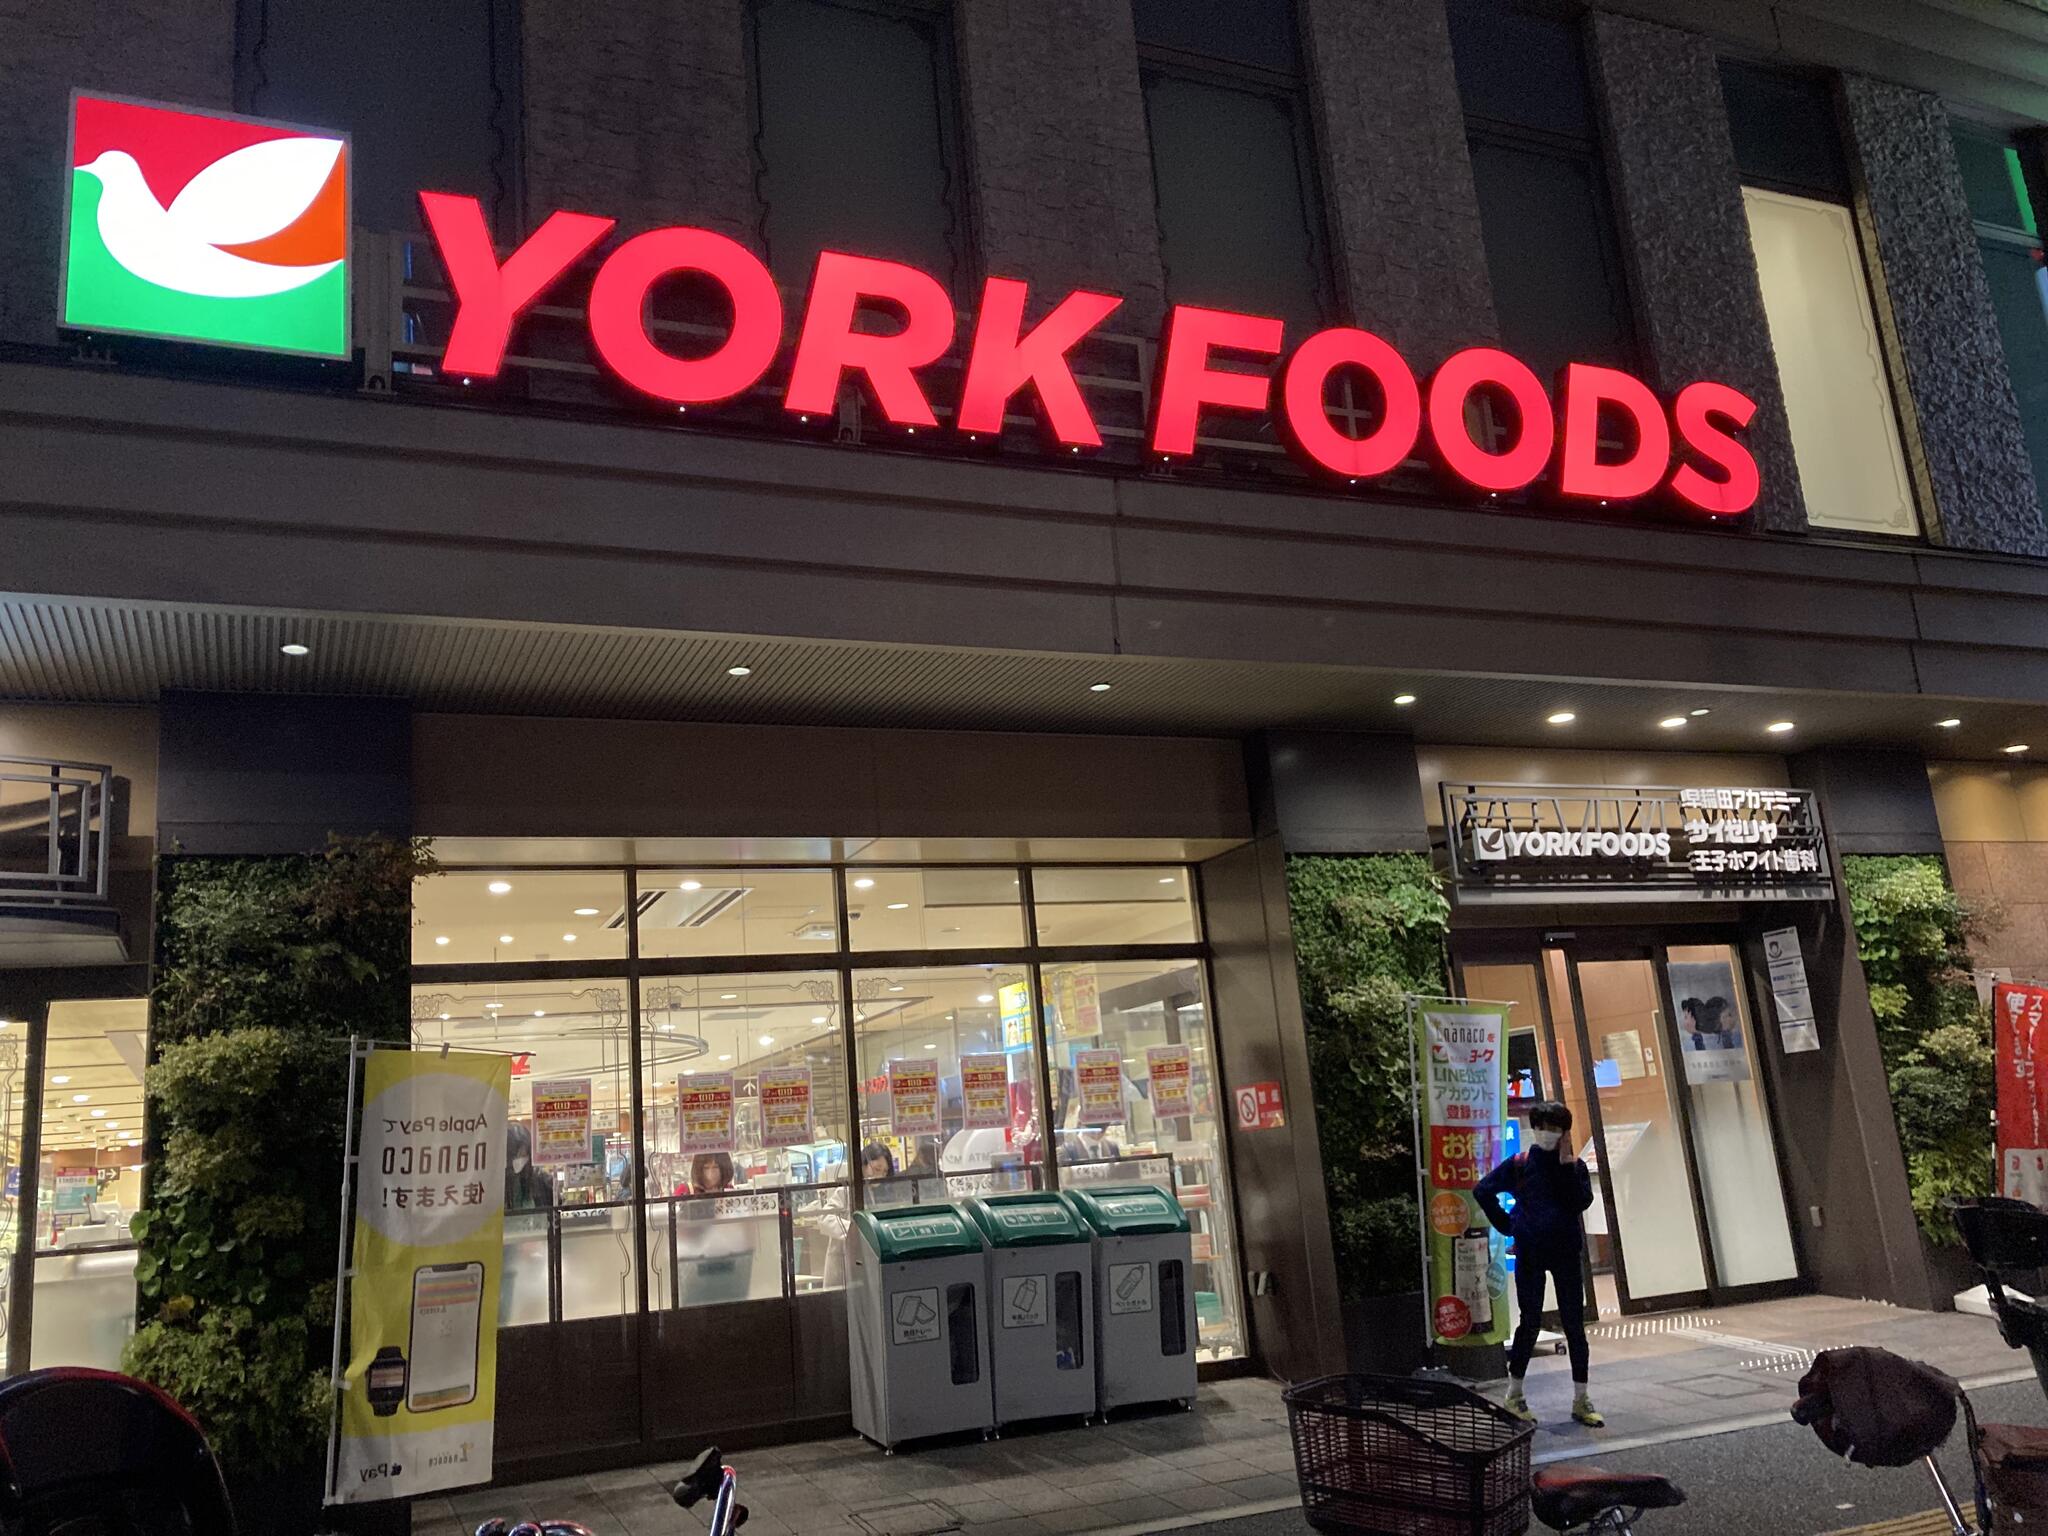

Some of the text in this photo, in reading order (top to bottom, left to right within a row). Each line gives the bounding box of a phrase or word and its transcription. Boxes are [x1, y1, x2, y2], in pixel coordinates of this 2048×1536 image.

[418, 190, 1761, 515] YORK FOODS
[1684, 818, 1778, 844] サイゼリヤ
[1690, 849, 1817, 872] 王子ホワイト歯科
